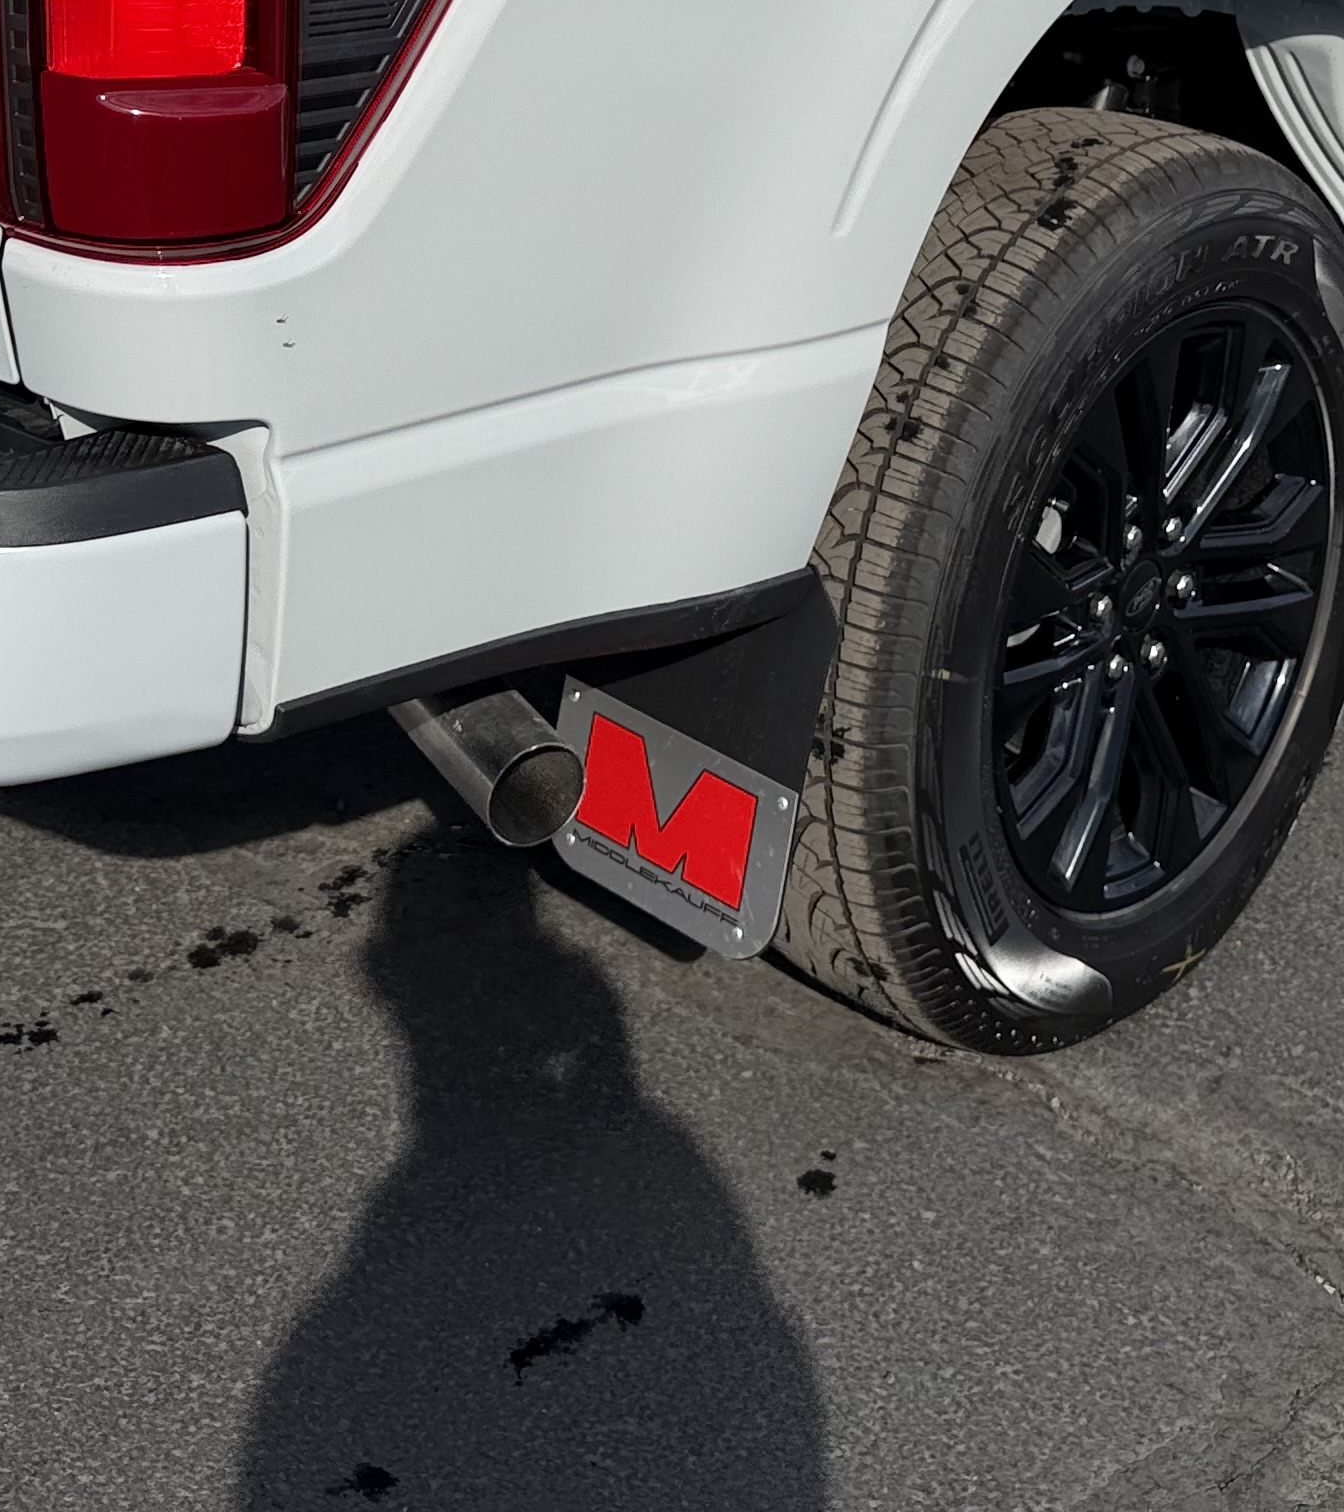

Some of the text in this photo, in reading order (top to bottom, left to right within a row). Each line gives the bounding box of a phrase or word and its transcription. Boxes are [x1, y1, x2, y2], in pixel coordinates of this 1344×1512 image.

[1222, 235, 1300, 266] ATR
[575, 711, 758, 912] M
[572, 827, 739, 927] MIDDLEKAUFF
